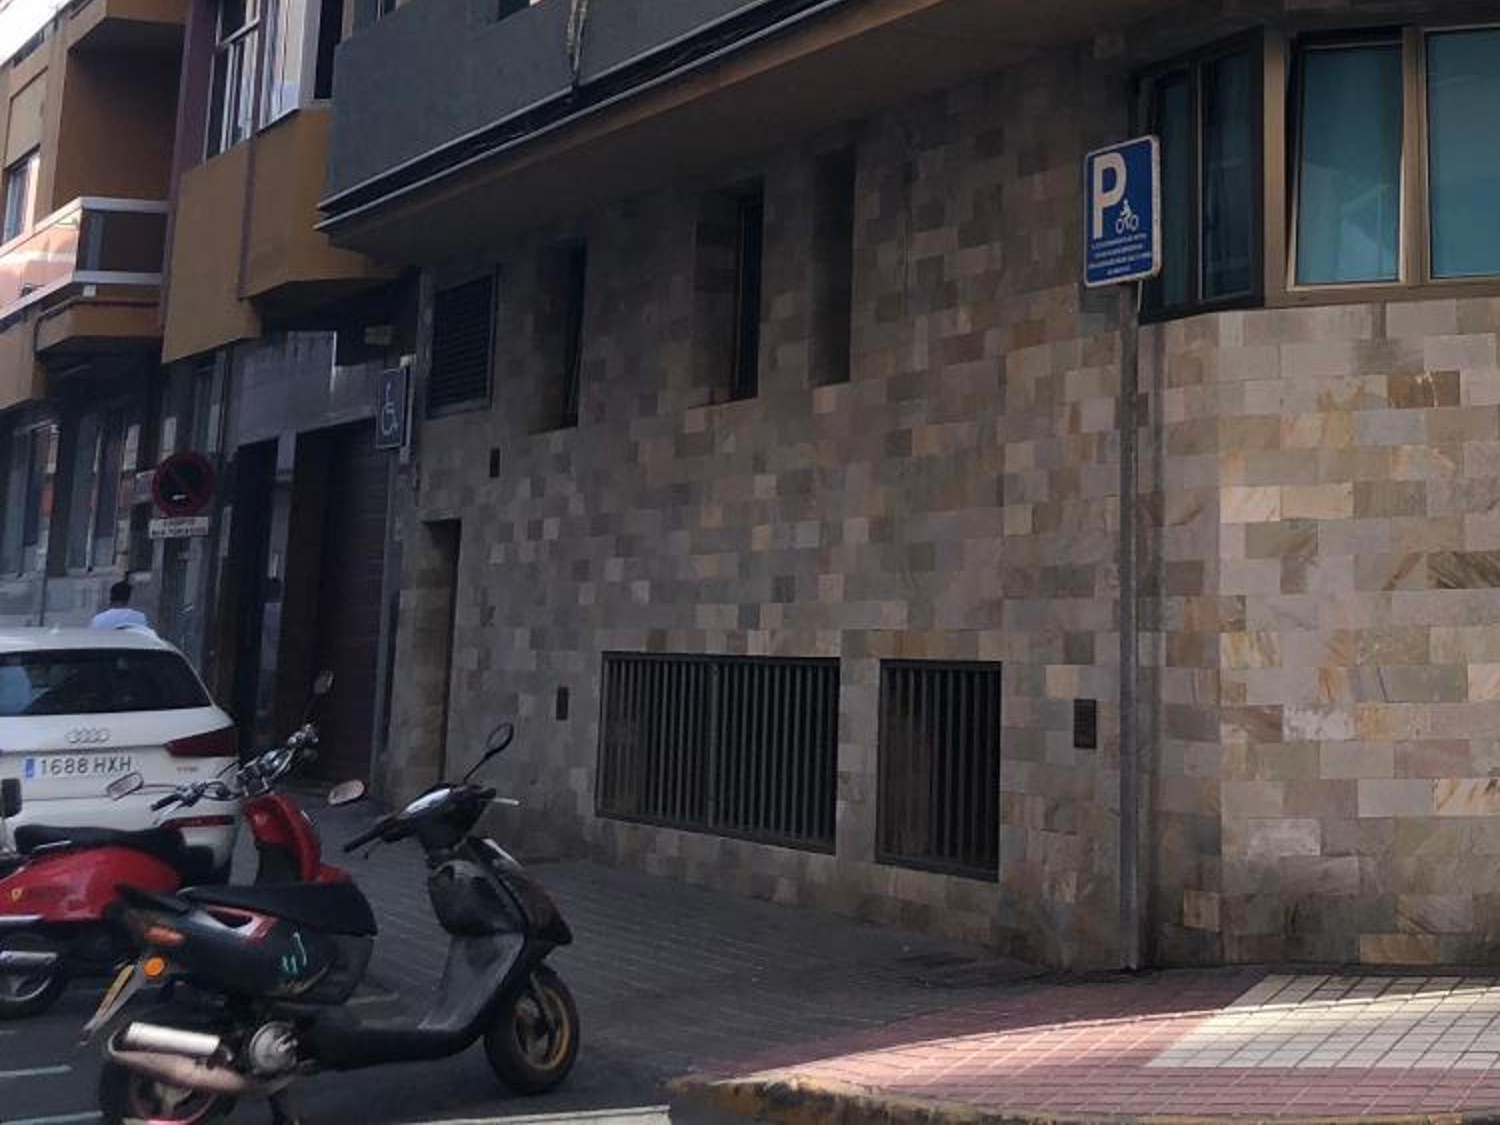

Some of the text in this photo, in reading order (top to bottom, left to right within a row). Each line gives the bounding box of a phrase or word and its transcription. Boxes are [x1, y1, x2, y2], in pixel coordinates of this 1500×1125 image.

[1092, 152, 1127, 240] P
[40, 754, 132, 774] 1688 HXH
